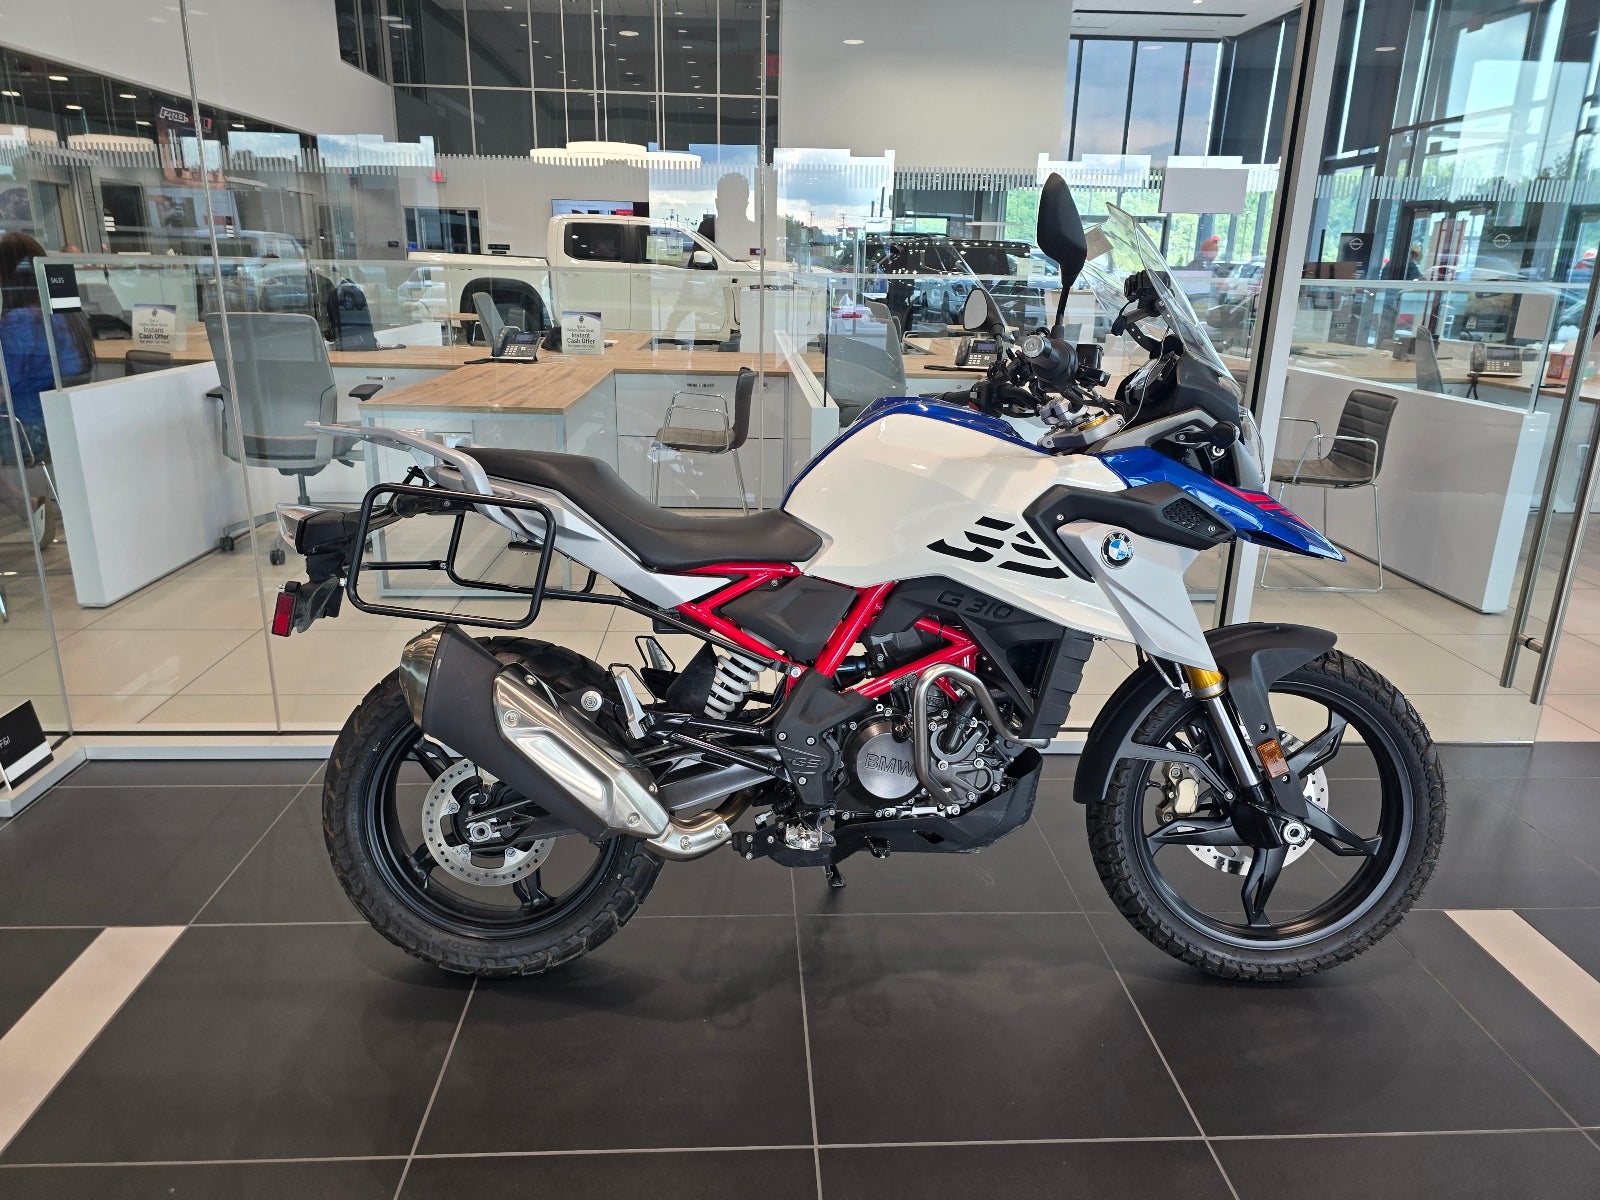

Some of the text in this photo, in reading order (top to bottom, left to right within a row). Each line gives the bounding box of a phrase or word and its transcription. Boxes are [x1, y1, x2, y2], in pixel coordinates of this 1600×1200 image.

[936, 589, 1014, 620] G 310
[864, 752, 916, 778] BMW
